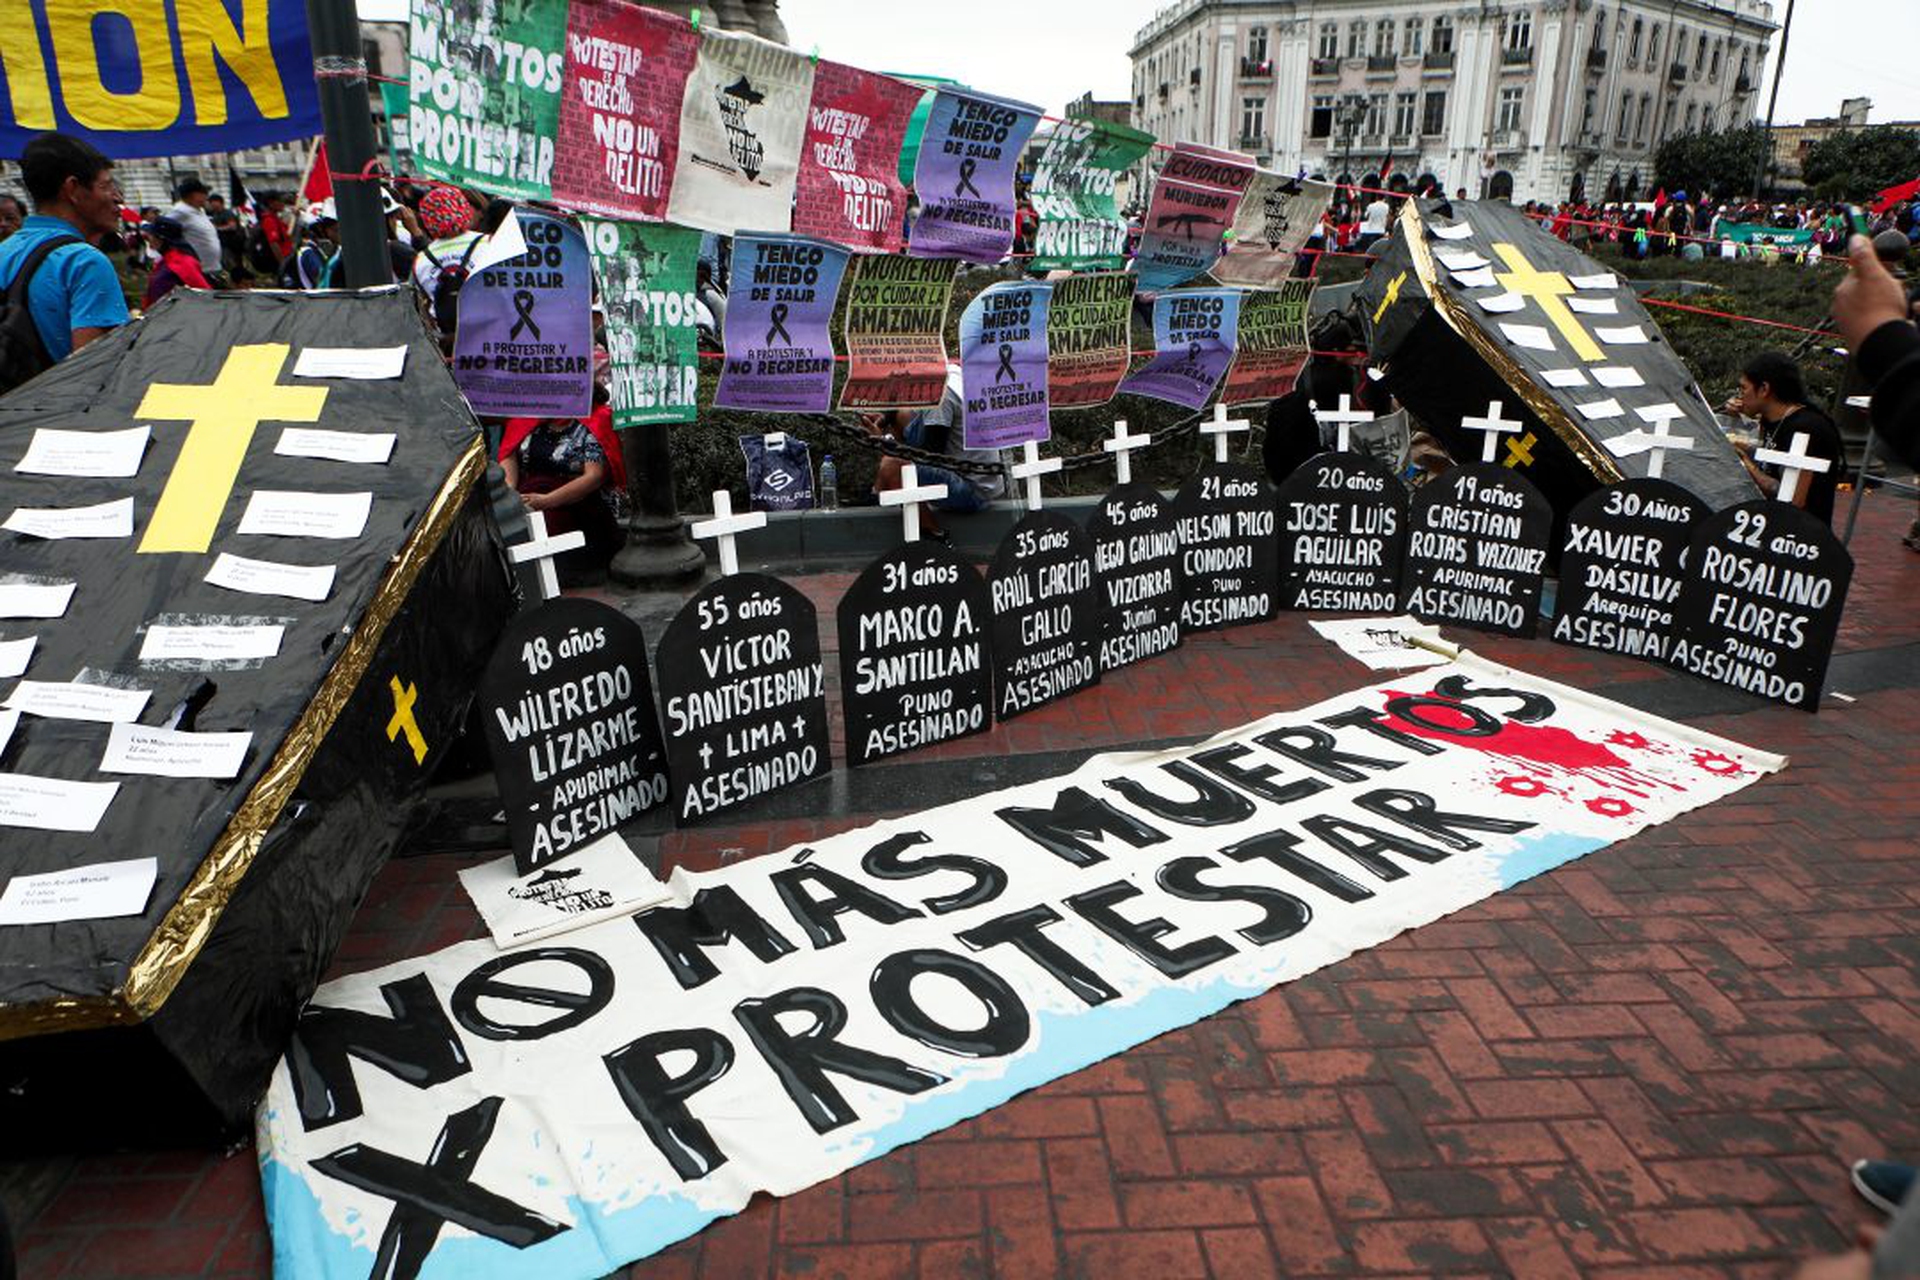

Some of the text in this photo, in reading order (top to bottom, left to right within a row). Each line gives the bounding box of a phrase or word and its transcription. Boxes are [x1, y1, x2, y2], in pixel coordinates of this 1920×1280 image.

[956, 99, 1018, 127] TENGO
[410, 104, 554, 186] PROTESTAR
[593, 113, 659, 157] NO UN
[948, 118, 1009, 144] MIEDO
[943, 139, 1002, 161] DE SALIR
[604, 150, 664, 198] DELITO
[843, 193, 892, 232] DELITO
[1164, 186, 1229, 210] MURIERON
[923, 203, 1012, 232] NO REGRESAR
[756, 244, 824, 265] TENGO
[483, 271, 563, 288] DE SALIR
[753, 265, 818, 285] MIEDO
[751, 288, 815, 302] DE SALIR
[852, 285, 945, 305] POR CUIDAR LA
[981, 292, 1033, 312] TENGO
[1170, 297, 1224, 314] TENGO
[982, 310, 1031, 330] MIEDO
[1072, 305, 1114, 326] CUIDAR
[1169, 313, 1222, 331] MIEDO
[494, 342, 556, 355] PROTESTAR
[560, 342, 567, 354] Y
[981, 328, 1031, 344] DE SALIR
[459, 355, 588, 374] NO REGRESAR
[728, 358, 829, 375] NO REGRESAR
[968, 391, 1045, 413] NO REGRESAR
[1201, 476, 1258, 500] 21 años
[1317, 467, 1384, 491] 20 años
[1454, 476, 1524, 509] 19 años
[1107, 501, 1158, 525] 45 años
[1287, 502, 1341, 532] JOSE
[1603, 491, 1641, 516] 30
[1237, 511, 1274, 536] PILCO
[1427, 504, 1522, 539] CRISTIAN
[1727, 510, 1820, 560] 22 años
[1015, 527, 1069, 558] 35 años
[1294, 535, 1382, 566] AGUILAR
[1410, 531, 1546, 575] ROJAS VAZQUEZ
[1564, 523, 1663, 567] XAVIER
[883, 559, 958, 592] 31 años
[1184, 545, 1252, 576] CONDORI
[992, 566, 1033, 614] RAÚL
[1107, 568, 1172, 607] VIZCARRA
[1212, 579, 1241, 592] PUNO
[1306, 569, 1374, 586] AYACUCHO
[1433, 568, 1513, 596] APURIMAC
[1701, 546, 1832, 609] ROSALINO
[698, 592, 782, 630] 55 años
[1180, 594, 1269, 626] ASESINADO
[1294, 588, 1395, 611] ASESINADO
[1406, 586, 1524, 629] ASESINADO
[860, 599, 980, 651] MARCO A.
[1022, 604, 1071, 646] GALLO
[1709, 593, 1809, 649] FLORES
[522, 627, 605, 675] 18 años
[1100, 621, 1178, 670] ASESINADO
[1724, 638, 1777, 668] PUNO
[856, 642, 980, 694] SANTILLAN
[1670, 639, 1805, 704] ASESINADO
[1002, 655, 1093, 714] ASESINADO
[495, 664, 631, 742] WILFREDO
[899, 688, 953, 716] PUNO
[529, 706, 640, 782] LIZARME
[726, 721, 786, 757] LIMA
[864, 703, 983, 758] ASESINADO
[552, 755, 639, 811] APURIMAC
[683, 745, 817, 818] ASESINADO
[531, 772, 668, 863] ASESINADO
[283, 674, 1556, 1132] NO MÁS MUERTOS
[307, 787, 1539, 1280] X PROTESTAR
